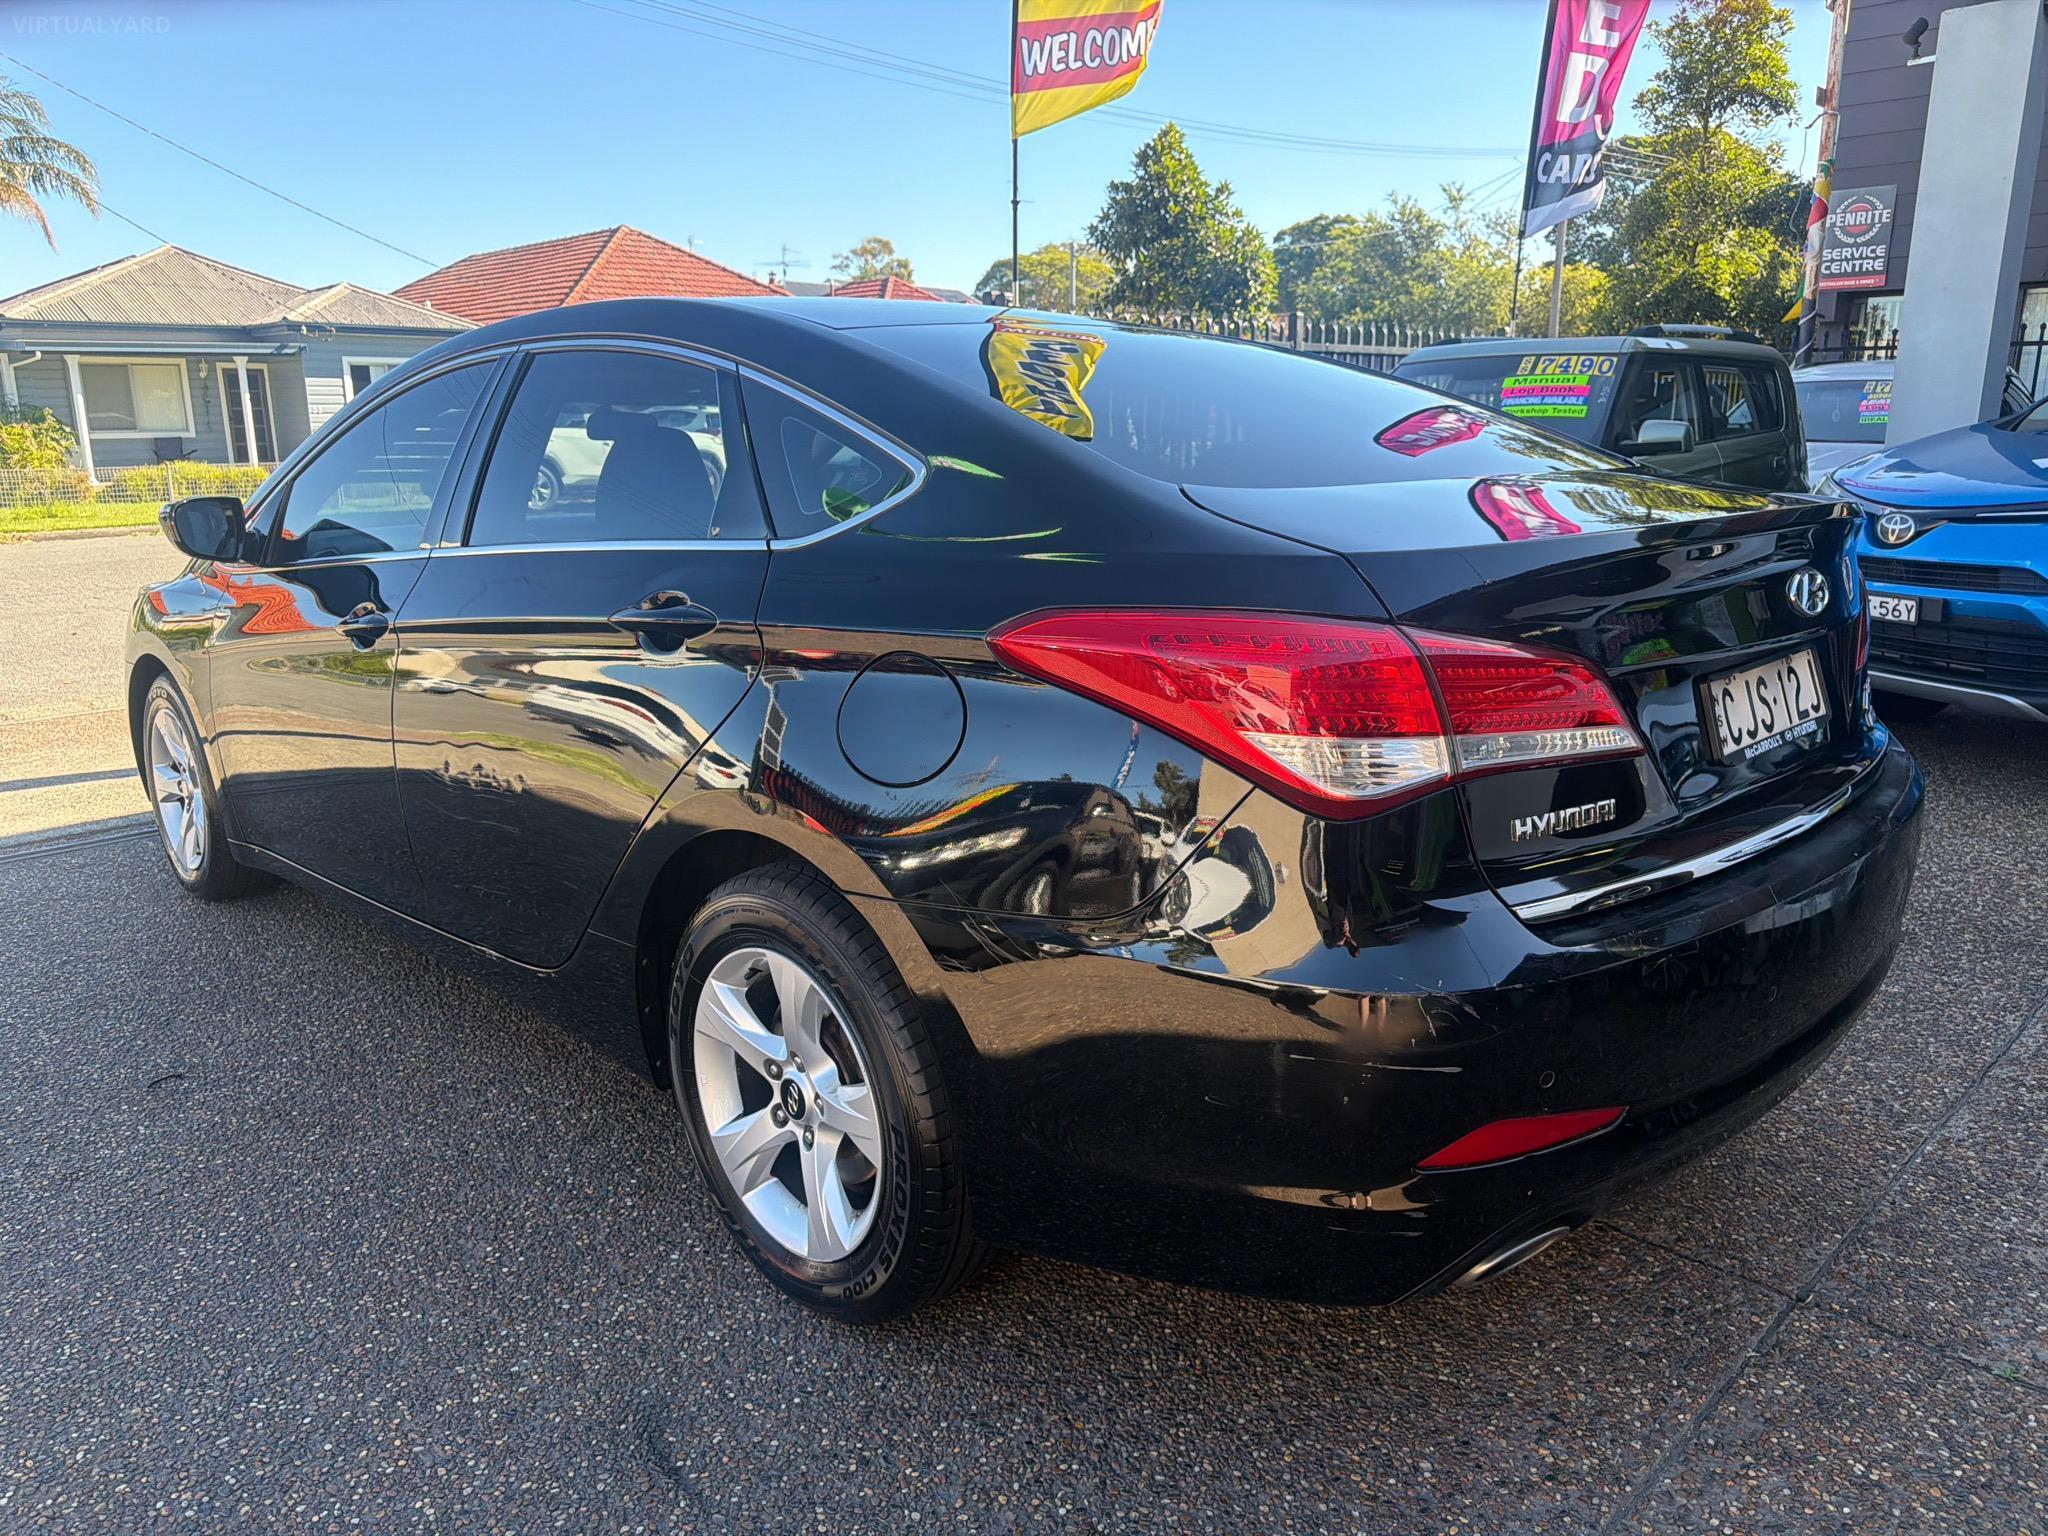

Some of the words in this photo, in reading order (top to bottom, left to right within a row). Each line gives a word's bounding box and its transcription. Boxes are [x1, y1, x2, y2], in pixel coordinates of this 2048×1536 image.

[1826, 208, 1892, 228] PENRITE
[1822, 244, 1887, 261] SERVICE
[1820, 258, 1884, 274] CENTRE
[1541, 357, 1615, 375] 7490
[1512, 376, 1577, 386] Manual
[1509, 386, 1535, 396] Log
[1540, 386, 1577, 394] Book
[1542, 396, 1585, 405] AVAILABLE
[1505, 406, 1549, 415] orkshop
[1551, 406, 1585, 416] Tested
[1744, 734, 1784, 760] McCARROLL'S
[1791, 719, 1818, 739] HYUNDAI
[1510, 798, 1616, 842] HYUNDAI
